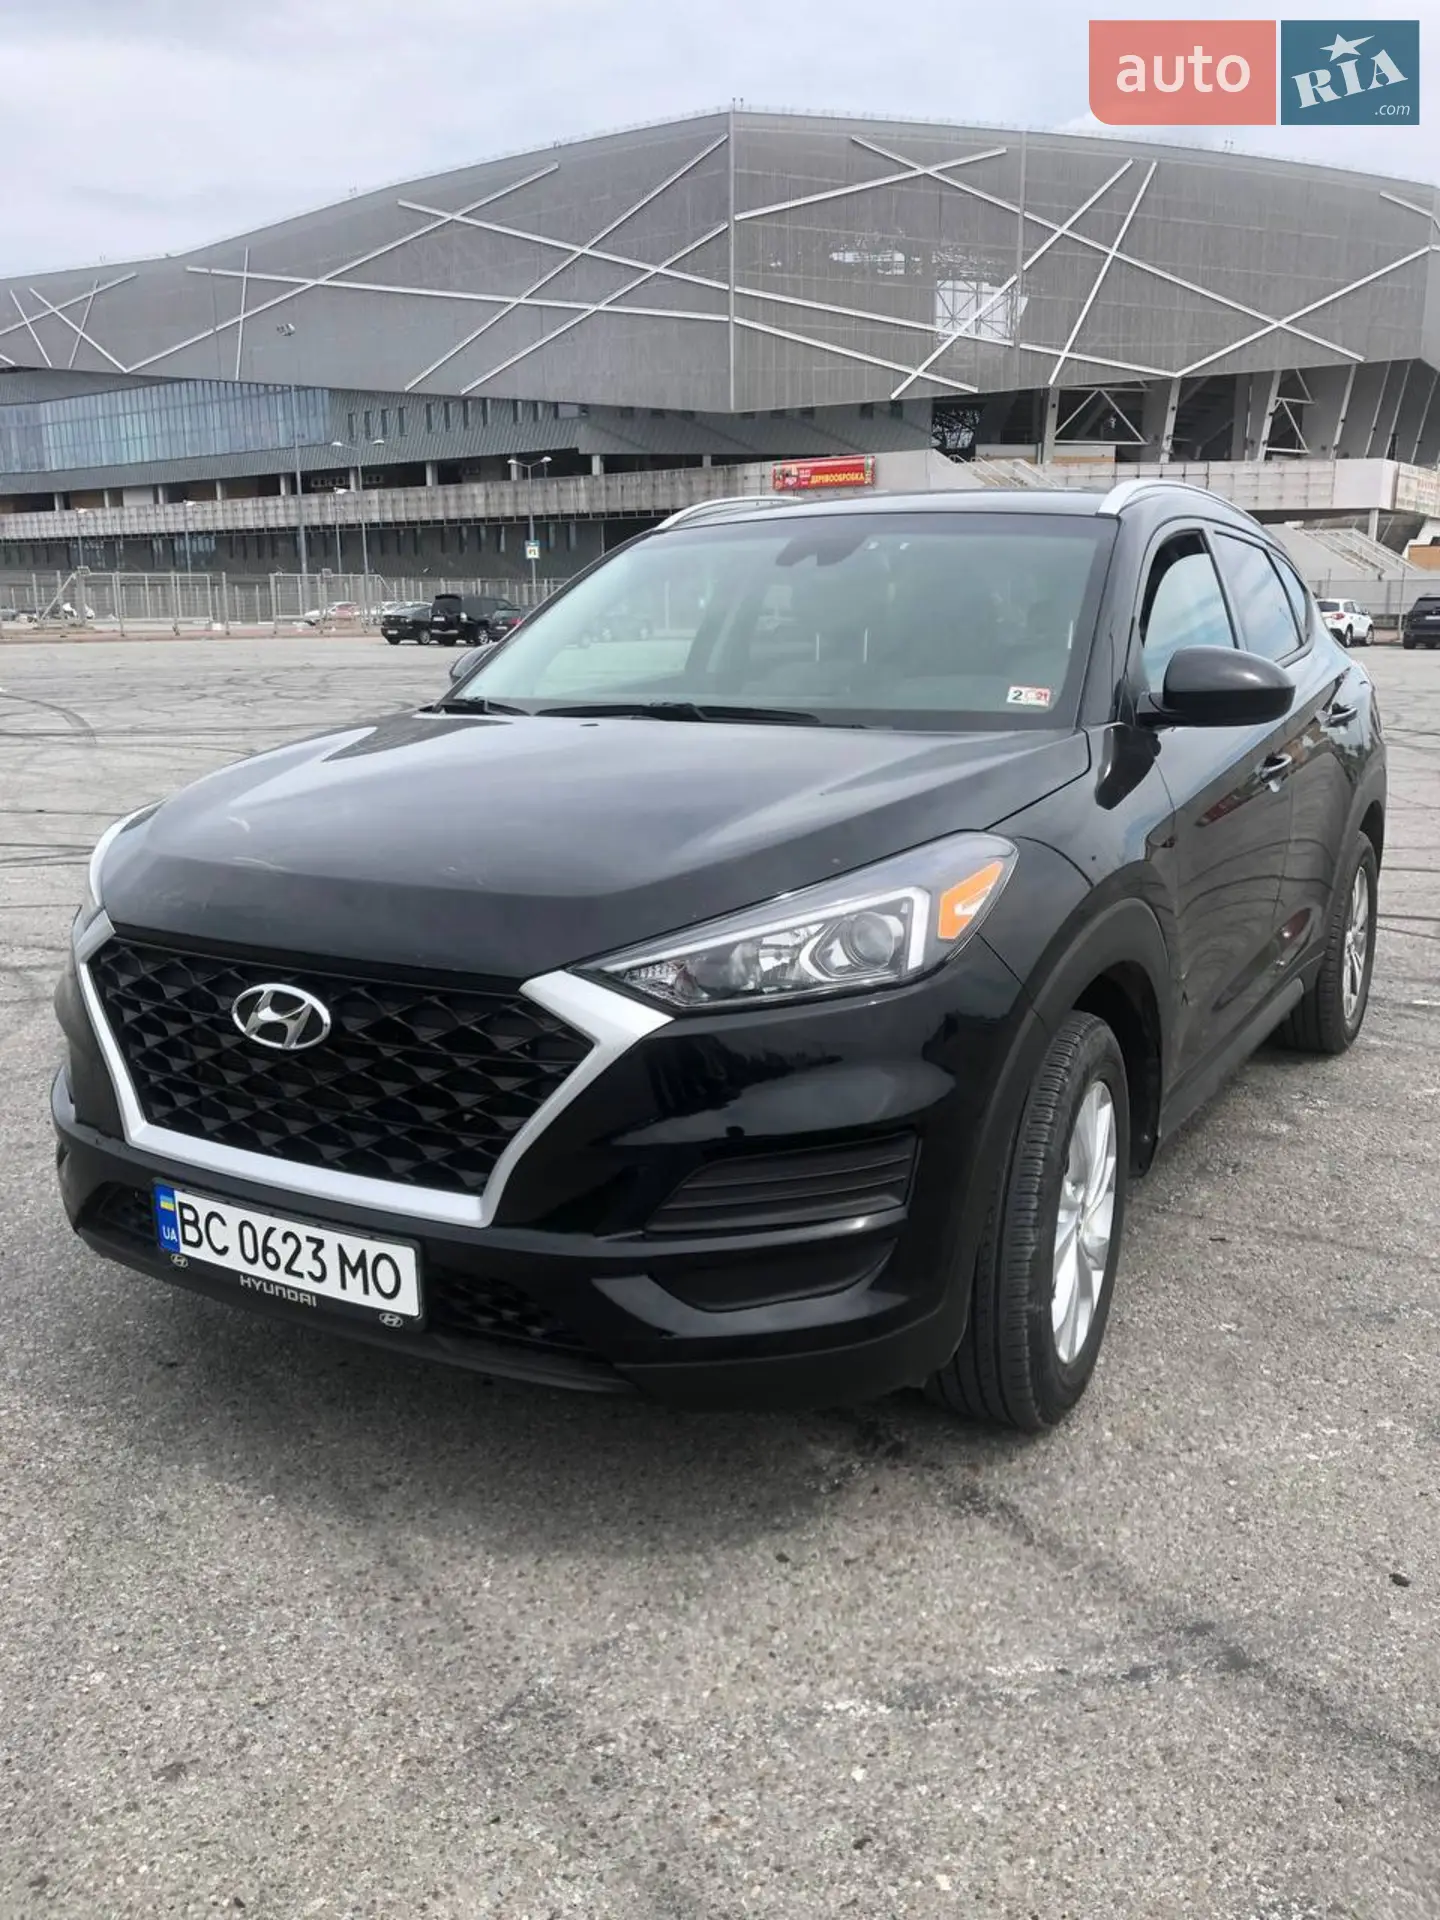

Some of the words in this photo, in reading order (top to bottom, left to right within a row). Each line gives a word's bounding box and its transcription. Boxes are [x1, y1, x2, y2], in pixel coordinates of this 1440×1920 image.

[163, 1227, 178, 1242] UA
[178, 1201, 229, 1256] BC
[238, 1220, 328, 1284] 0623
[338, 1243, 401, 1300] MO
[239, 1274, 317, 1308] HYUNDAI
